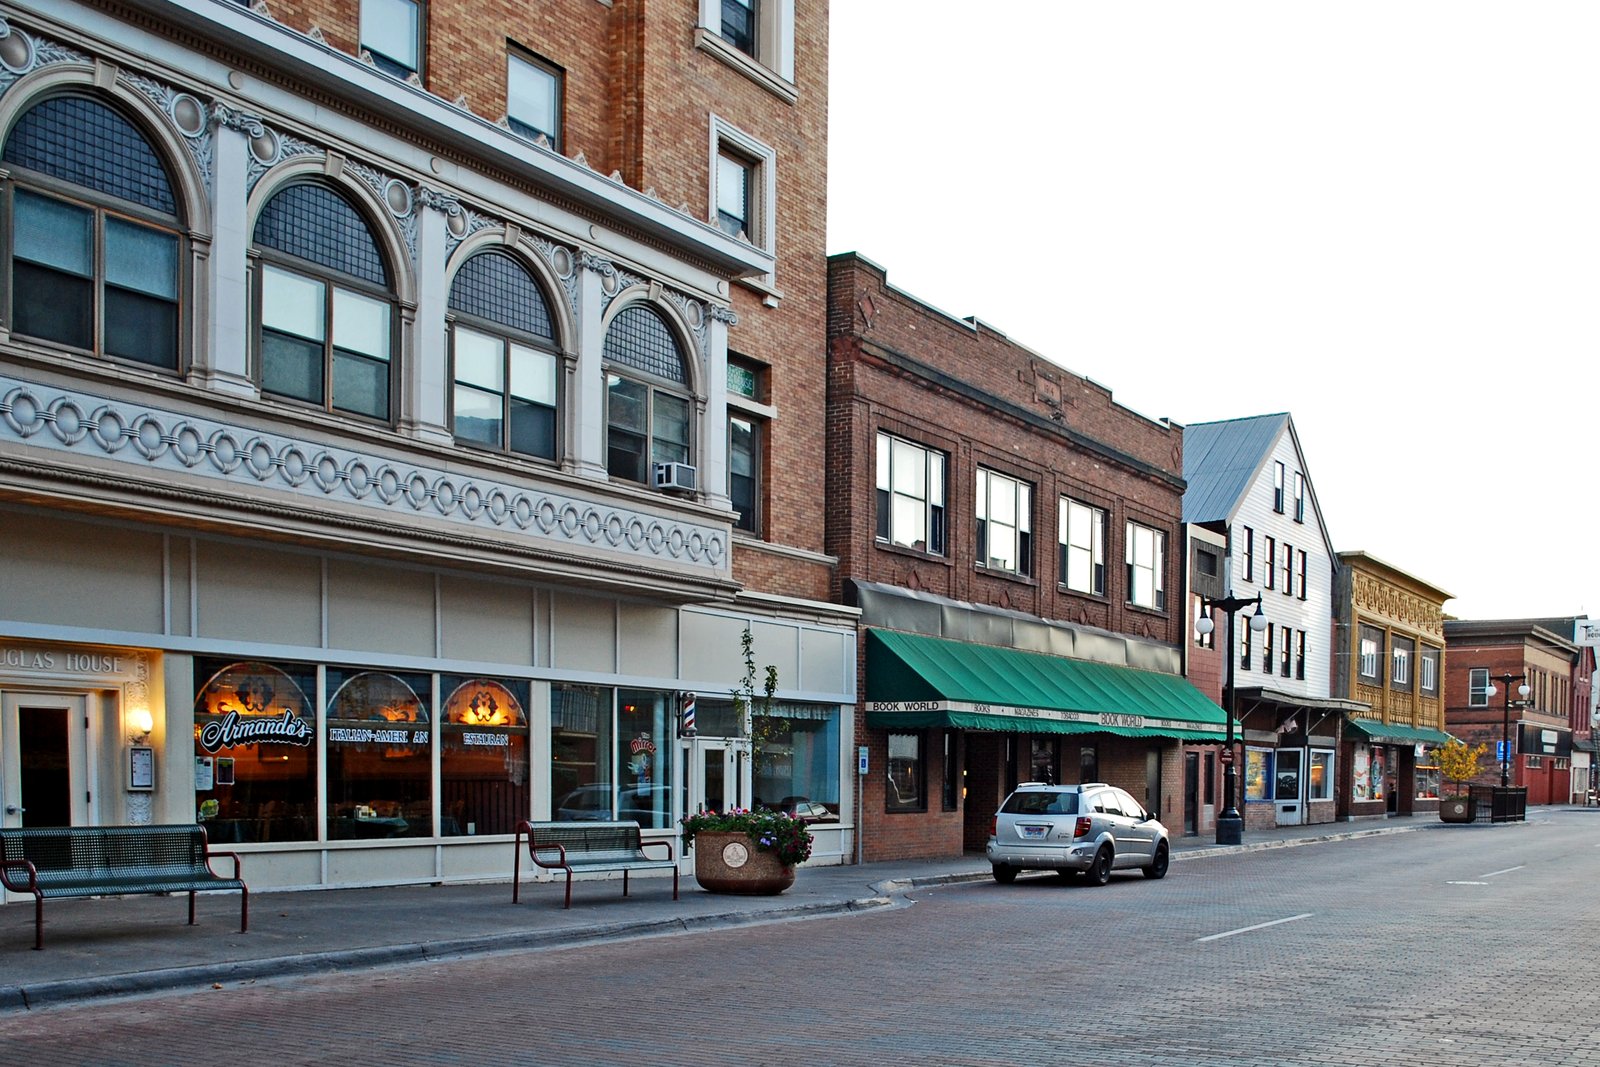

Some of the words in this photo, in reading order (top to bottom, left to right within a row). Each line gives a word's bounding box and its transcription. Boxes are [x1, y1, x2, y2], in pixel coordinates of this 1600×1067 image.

[66, 653, 124, 674] HOUSE
[873, 702, 899, 711] BOOK
[904, 702, 939, 710] WORLD
[974, 704, 991, 713] BOOKS
[1014, 708, 1039, 717] MAGAZINES
[1101, 713, 1118, 725] BOOK
[1120, 714, 1142, 727] WORLD
[201, 709, 313, 748] Armando's
